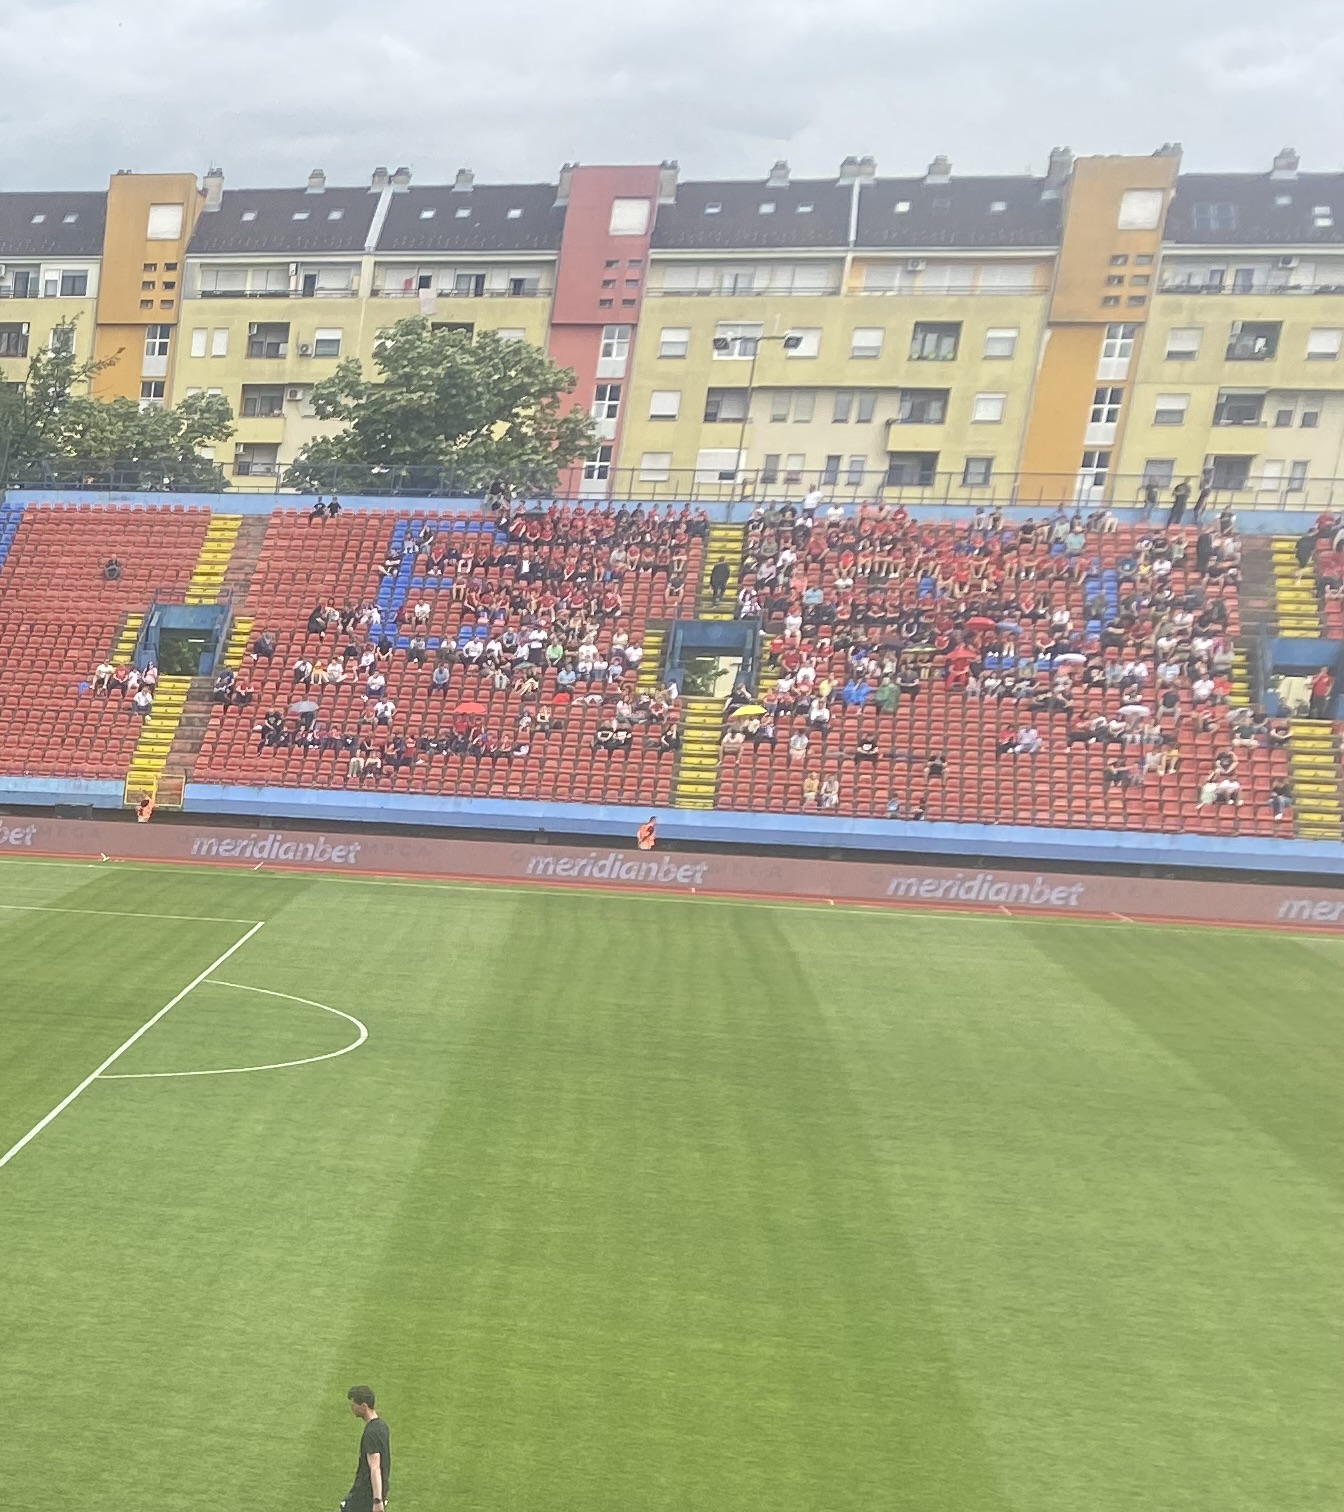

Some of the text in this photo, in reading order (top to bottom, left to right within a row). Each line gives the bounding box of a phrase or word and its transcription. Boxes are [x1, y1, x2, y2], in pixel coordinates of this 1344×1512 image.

[190, 834, 361, 864] meridianbet
[526, 852, 708, 884] meridianbet
[886, 873, 1085, 906] meridianbet
